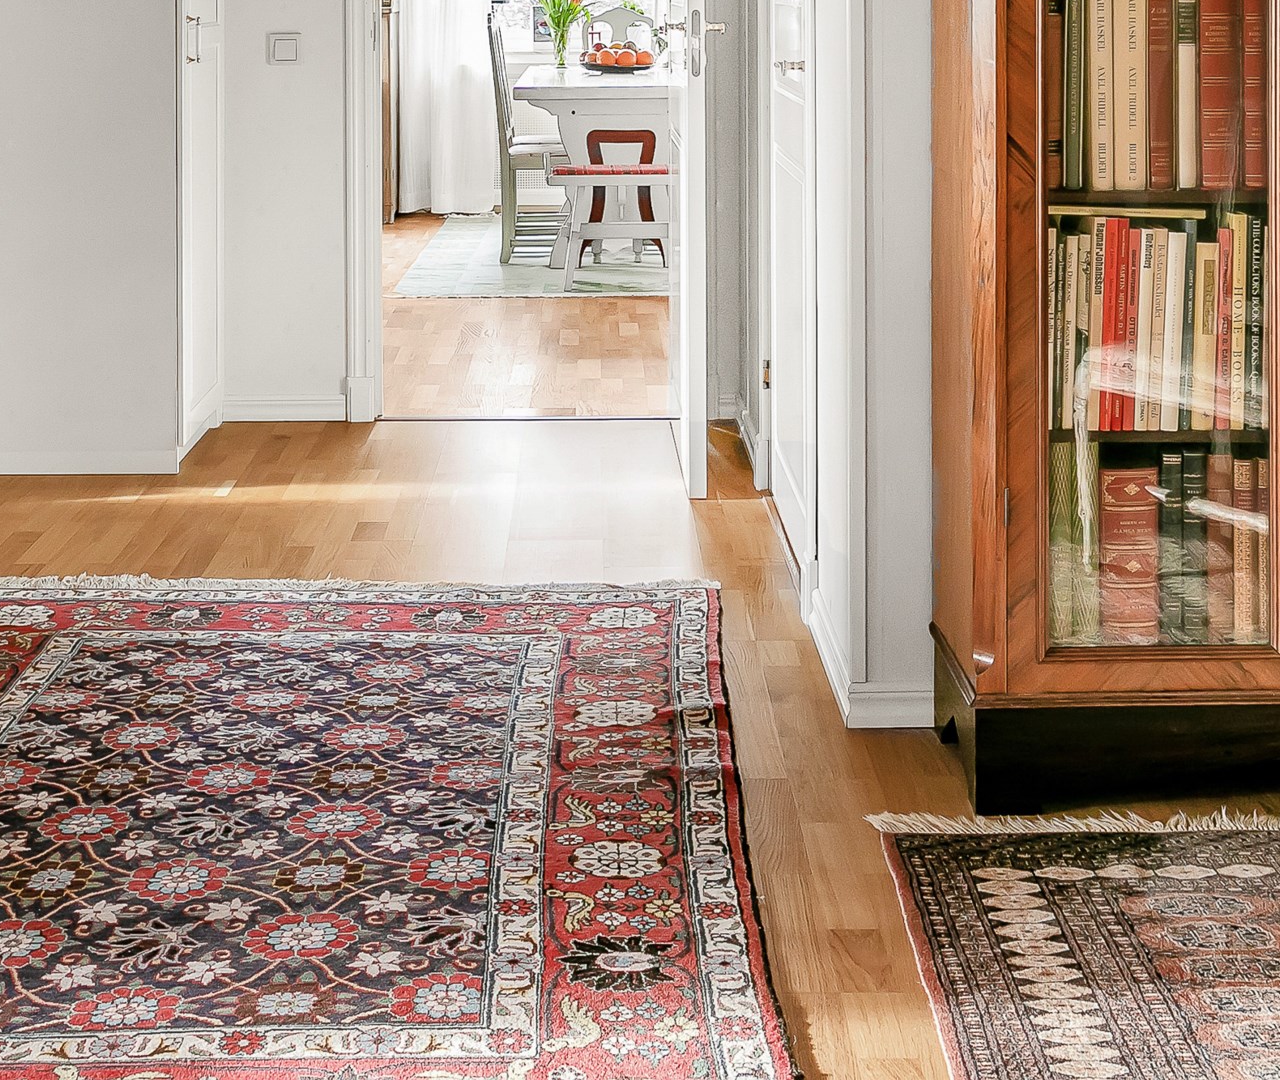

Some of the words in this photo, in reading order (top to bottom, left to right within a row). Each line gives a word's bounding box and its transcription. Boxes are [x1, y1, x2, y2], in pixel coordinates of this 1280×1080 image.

[1097, 17, 1105, 52] HASKEL
[1128, 17, 1136, 52] HASKEL
[1097, 65, 1106, 90] AXEL
[1128, 65, 1136, 90] AXEL
[1097, 92, 1106, 130] FRIDELL
[1128, 92, 1136, 130] FRIDELL
[1097, 142, 1106, 174] BILDER
[1128, 143, 1136, 174] BILDER
[1095, 223, 1105, 251] Ragnar
[1252, 219, 1261, 238] THE
[1094, 251, 1104, 295] Johansson
[1251, 238, 1261, 296] COLLECTOR'S
[1155, 298, 1164, 318] ordet
[1233, 286, 1243, 335] HOME
[1251, 296, 1261, 321] BOOK
[1251, 322, 1260, 334] OF
[1251, 335, 1260, 365] BOOKS
[1232, 350, 1242, 404] BOOKS
